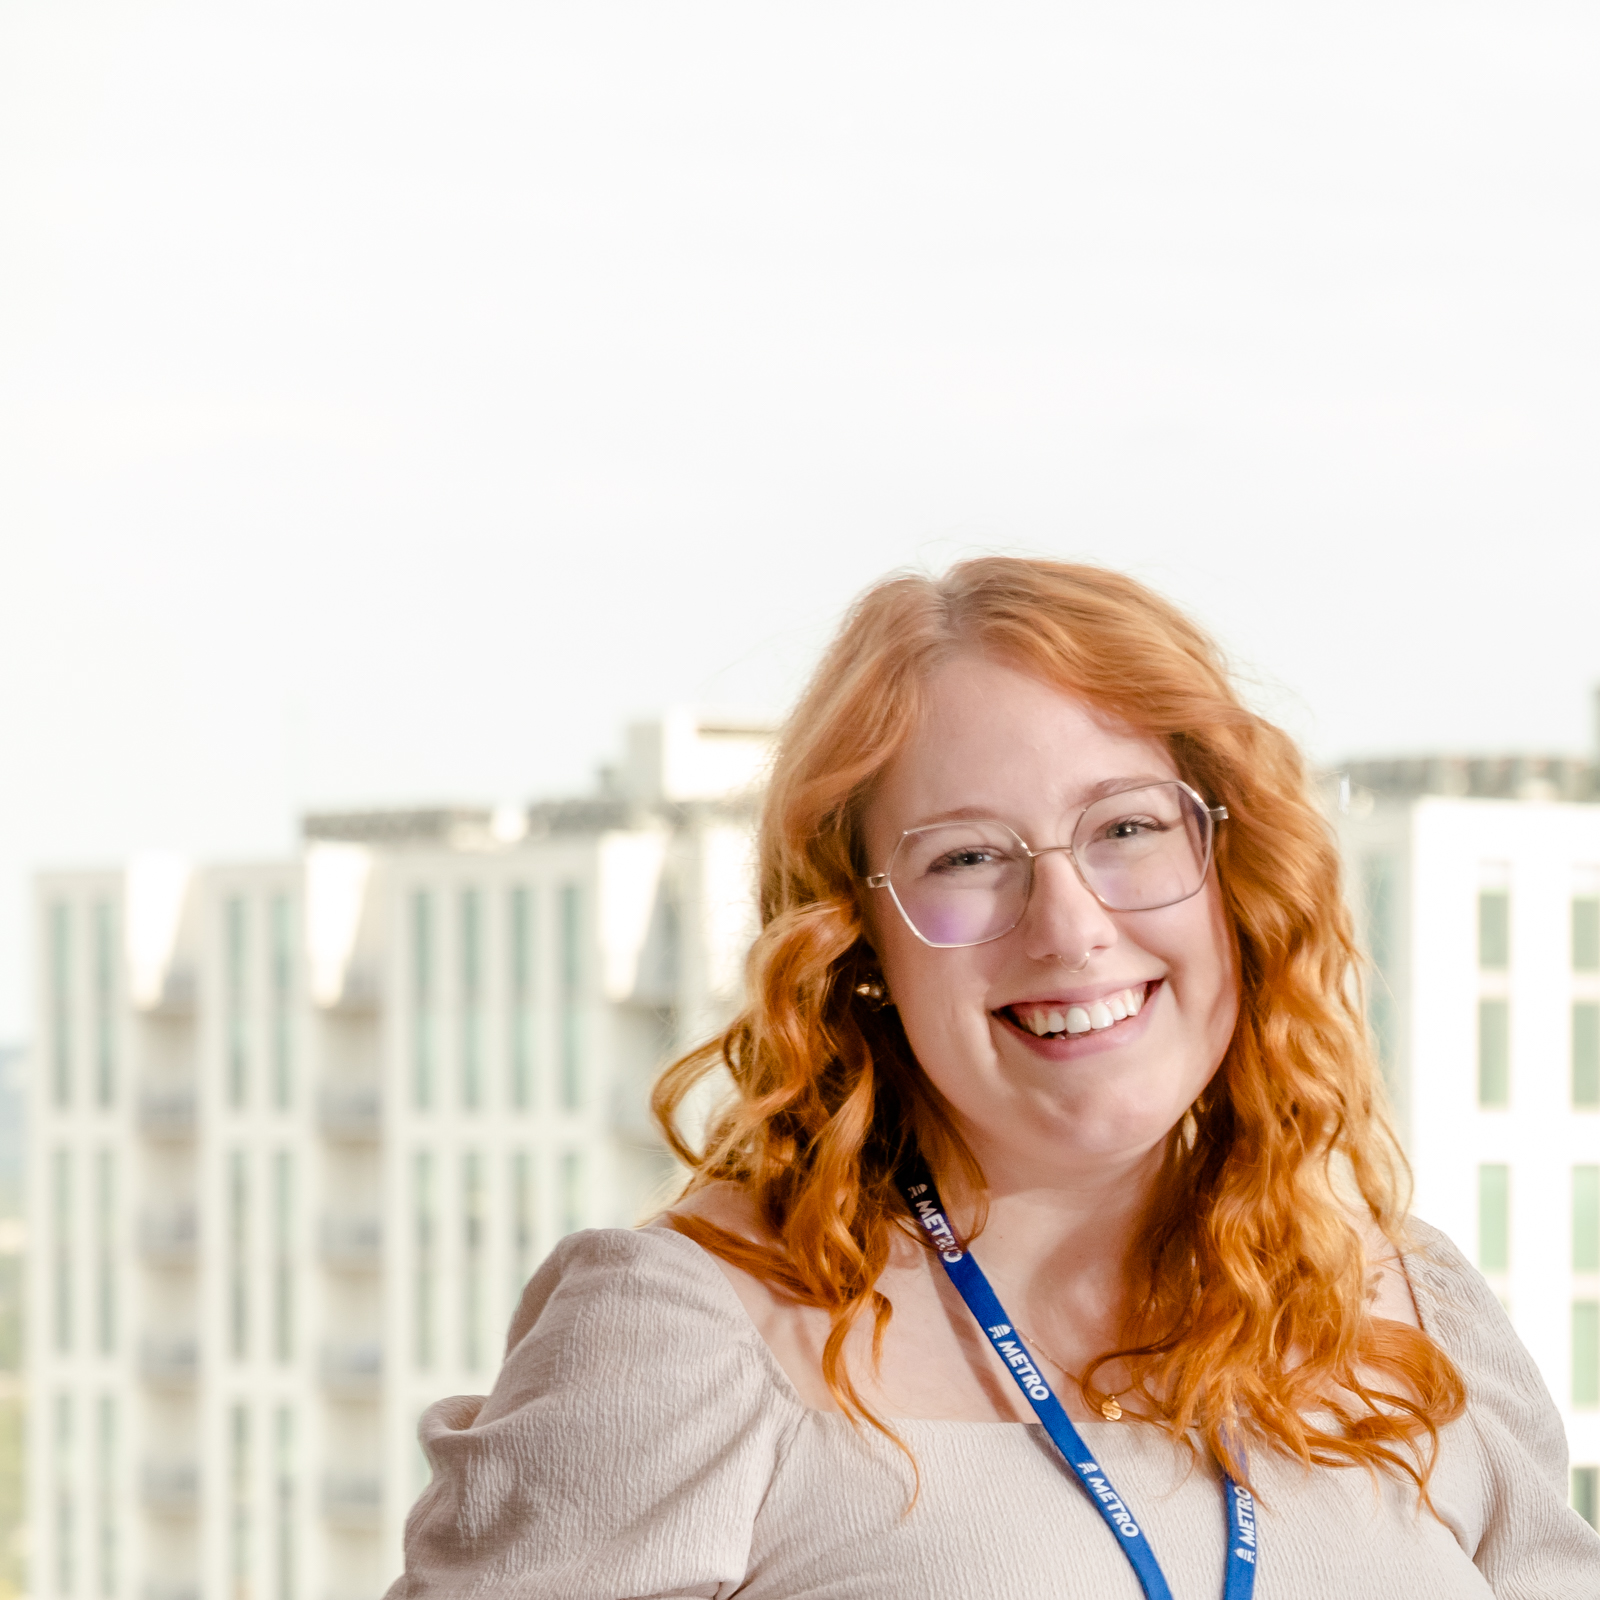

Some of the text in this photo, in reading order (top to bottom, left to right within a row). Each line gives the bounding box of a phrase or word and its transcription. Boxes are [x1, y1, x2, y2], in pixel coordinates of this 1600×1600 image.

[915, 1199, 963, 1263] METRO
[998, 1340, 1050, 1402] METRO
[1088, 1475, 1140, 1539] METRO
[1234, 1483, 1257, 1550] METRO
